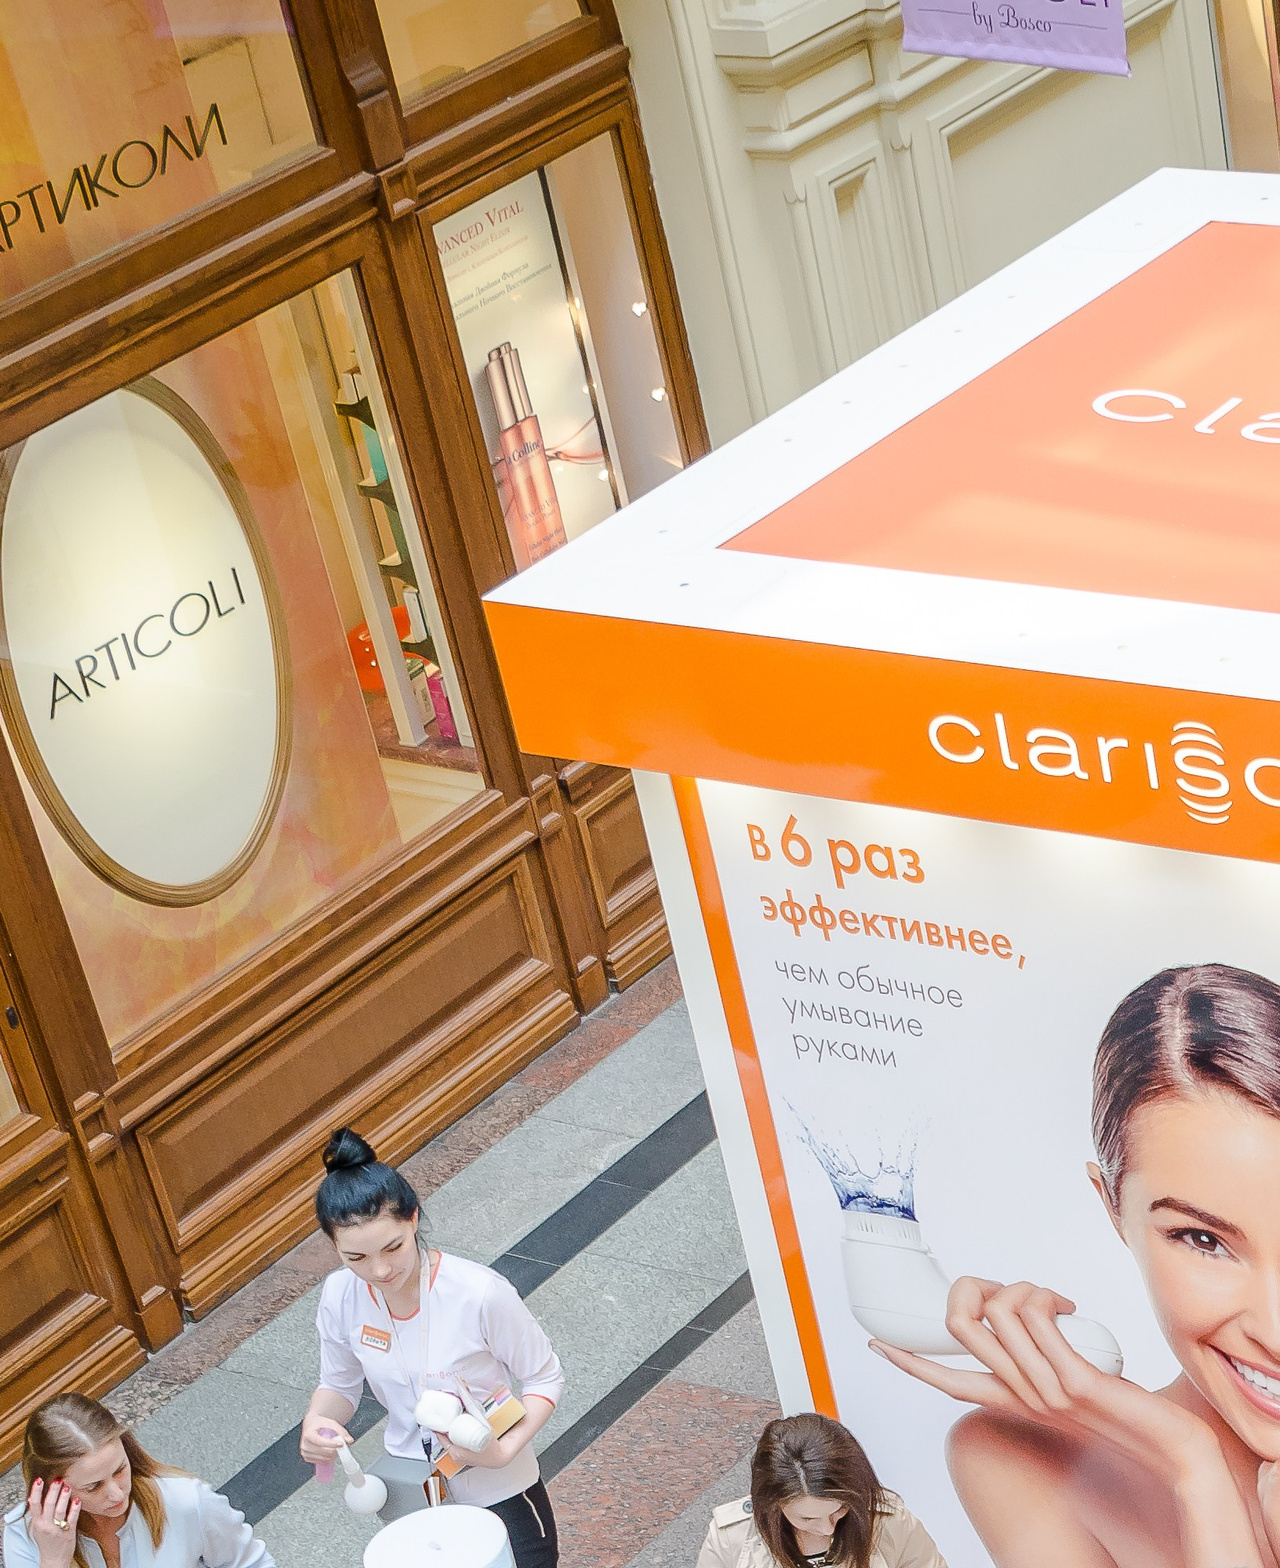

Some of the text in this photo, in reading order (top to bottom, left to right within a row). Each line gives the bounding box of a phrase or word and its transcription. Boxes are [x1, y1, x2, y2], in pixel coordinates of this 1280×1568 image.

[972, 2, 1052, 33] by Bosco
[0, 102, 228, 251] РТИКОЛИ
[484, 200, 524, 228] VITAL
[49, 566, 246, 720] ARTICOLI
[780, 813, 814, 868] 6
[826, 837, 926, 890] раз
[759, 888, 1026, 971] эффективнее,
[774, 959, 964, 1009] чем обычное
[782, 996, 924, 1038] умывание
[792, 1033, 898, 1069] руками
